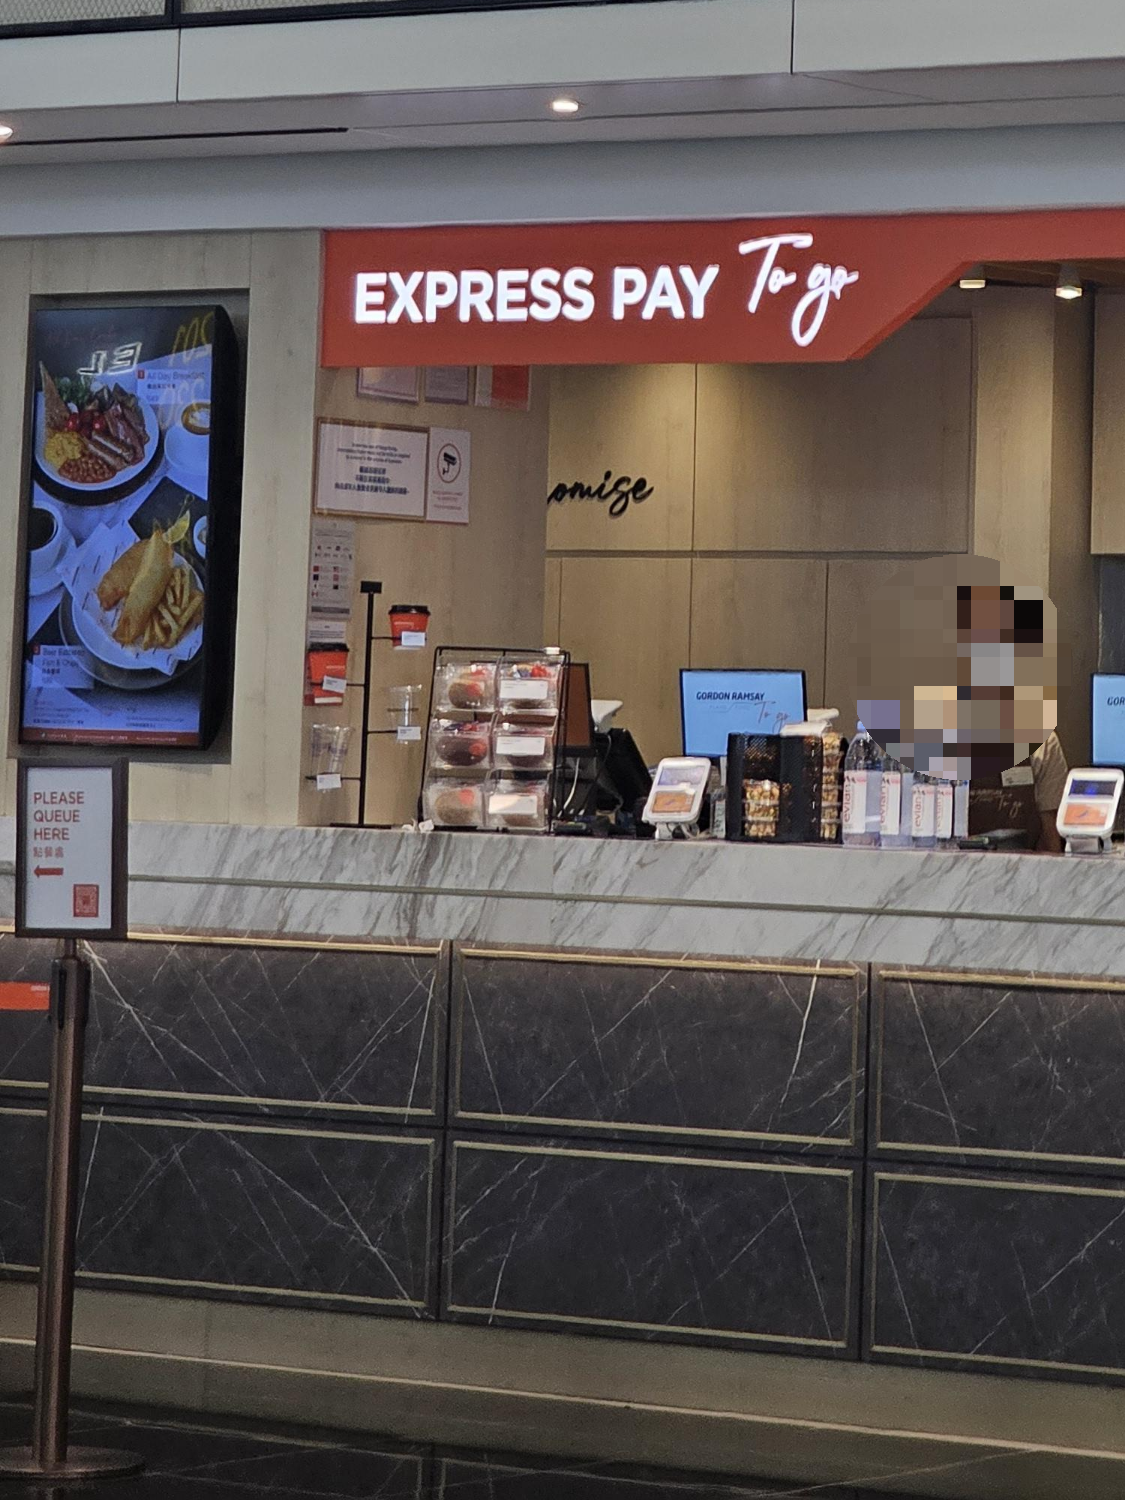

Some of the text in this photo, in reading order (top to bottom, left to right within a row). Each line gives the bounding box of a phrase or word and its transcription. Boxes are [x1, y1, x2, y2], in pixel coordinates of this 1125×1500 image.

[354, 232, 860, 347] EXPRESS PAY To go
[696, 690, 765, 701] GORDON RAMSAY
[754, 701, 777, 724] To
[33, 791, 85, 805] PLEASE
[33, 809, 81, 823] QUEUE
[33, 827, 71, 841] HERE
